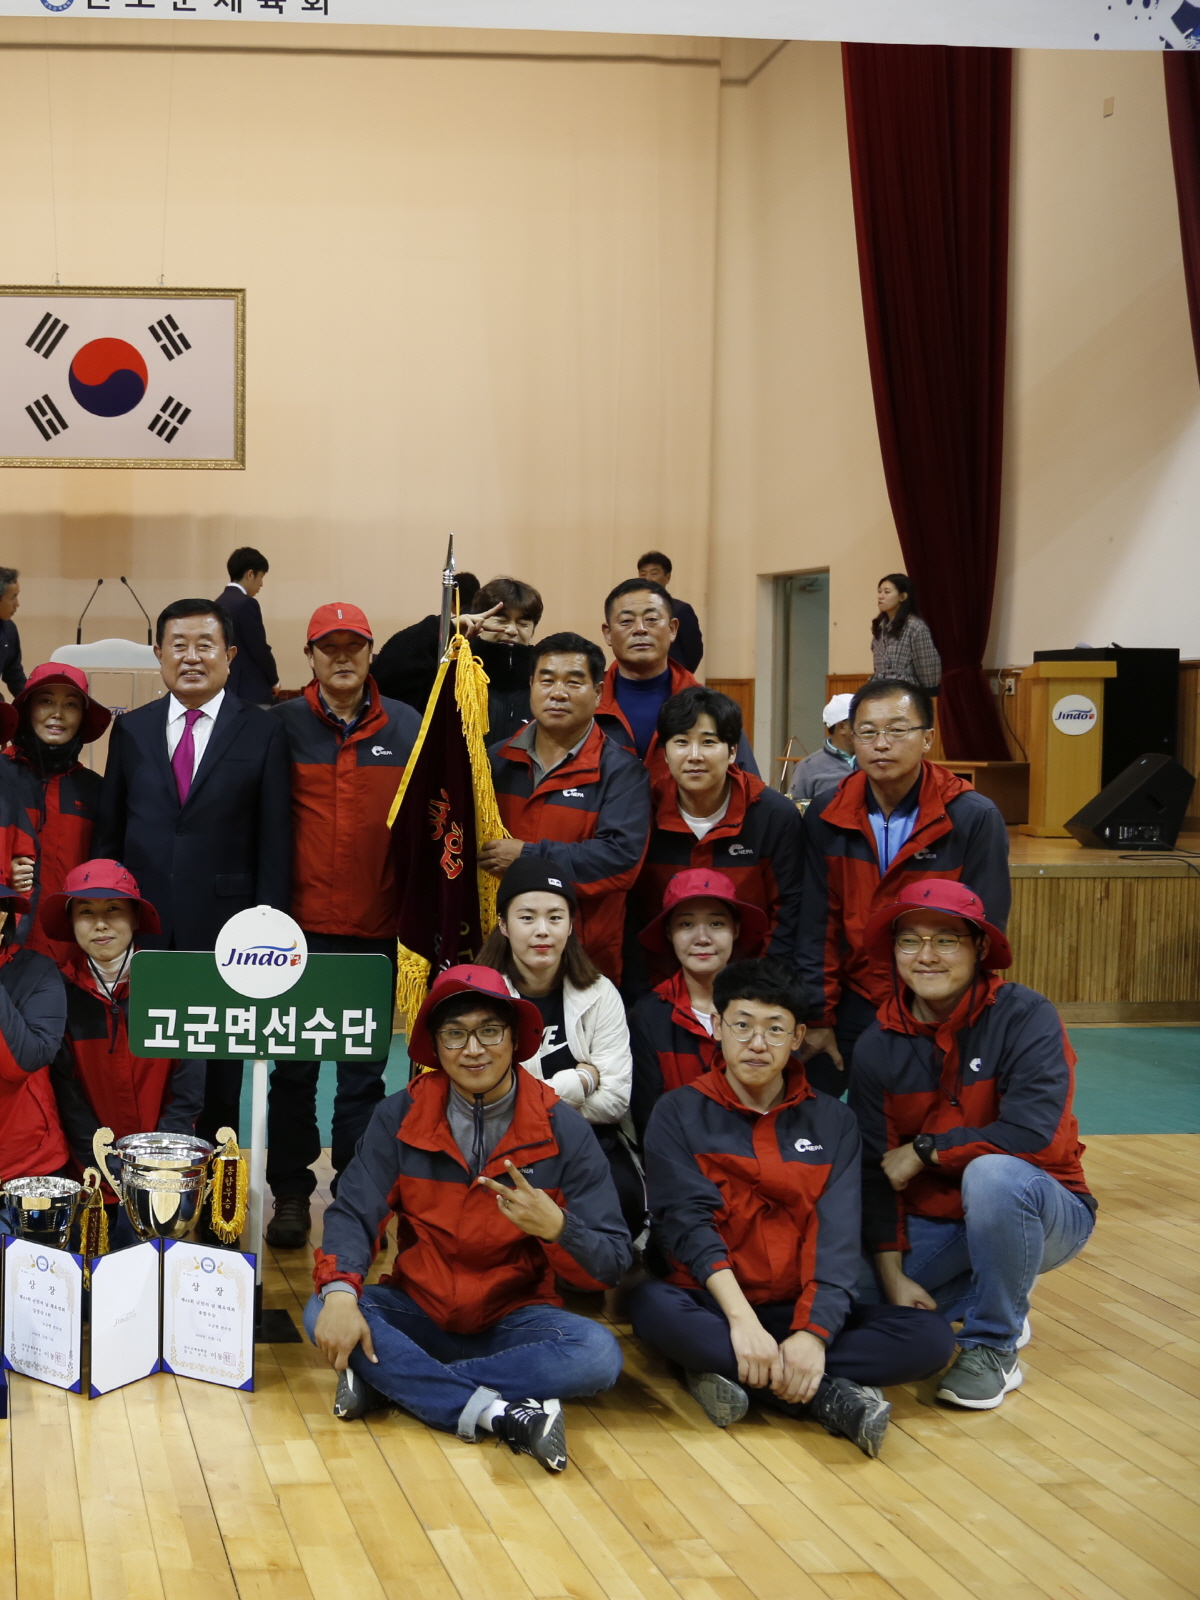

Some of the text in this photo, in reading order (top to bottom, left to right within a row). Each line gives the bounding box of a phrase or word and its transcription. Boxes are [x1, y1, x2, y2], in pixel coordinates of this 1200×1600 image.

[1054, 711, 1089, 721] Jindo
[221, 948, 289, 967] Jindo
[144, 1006, 377, 1055] 고군면선수단
